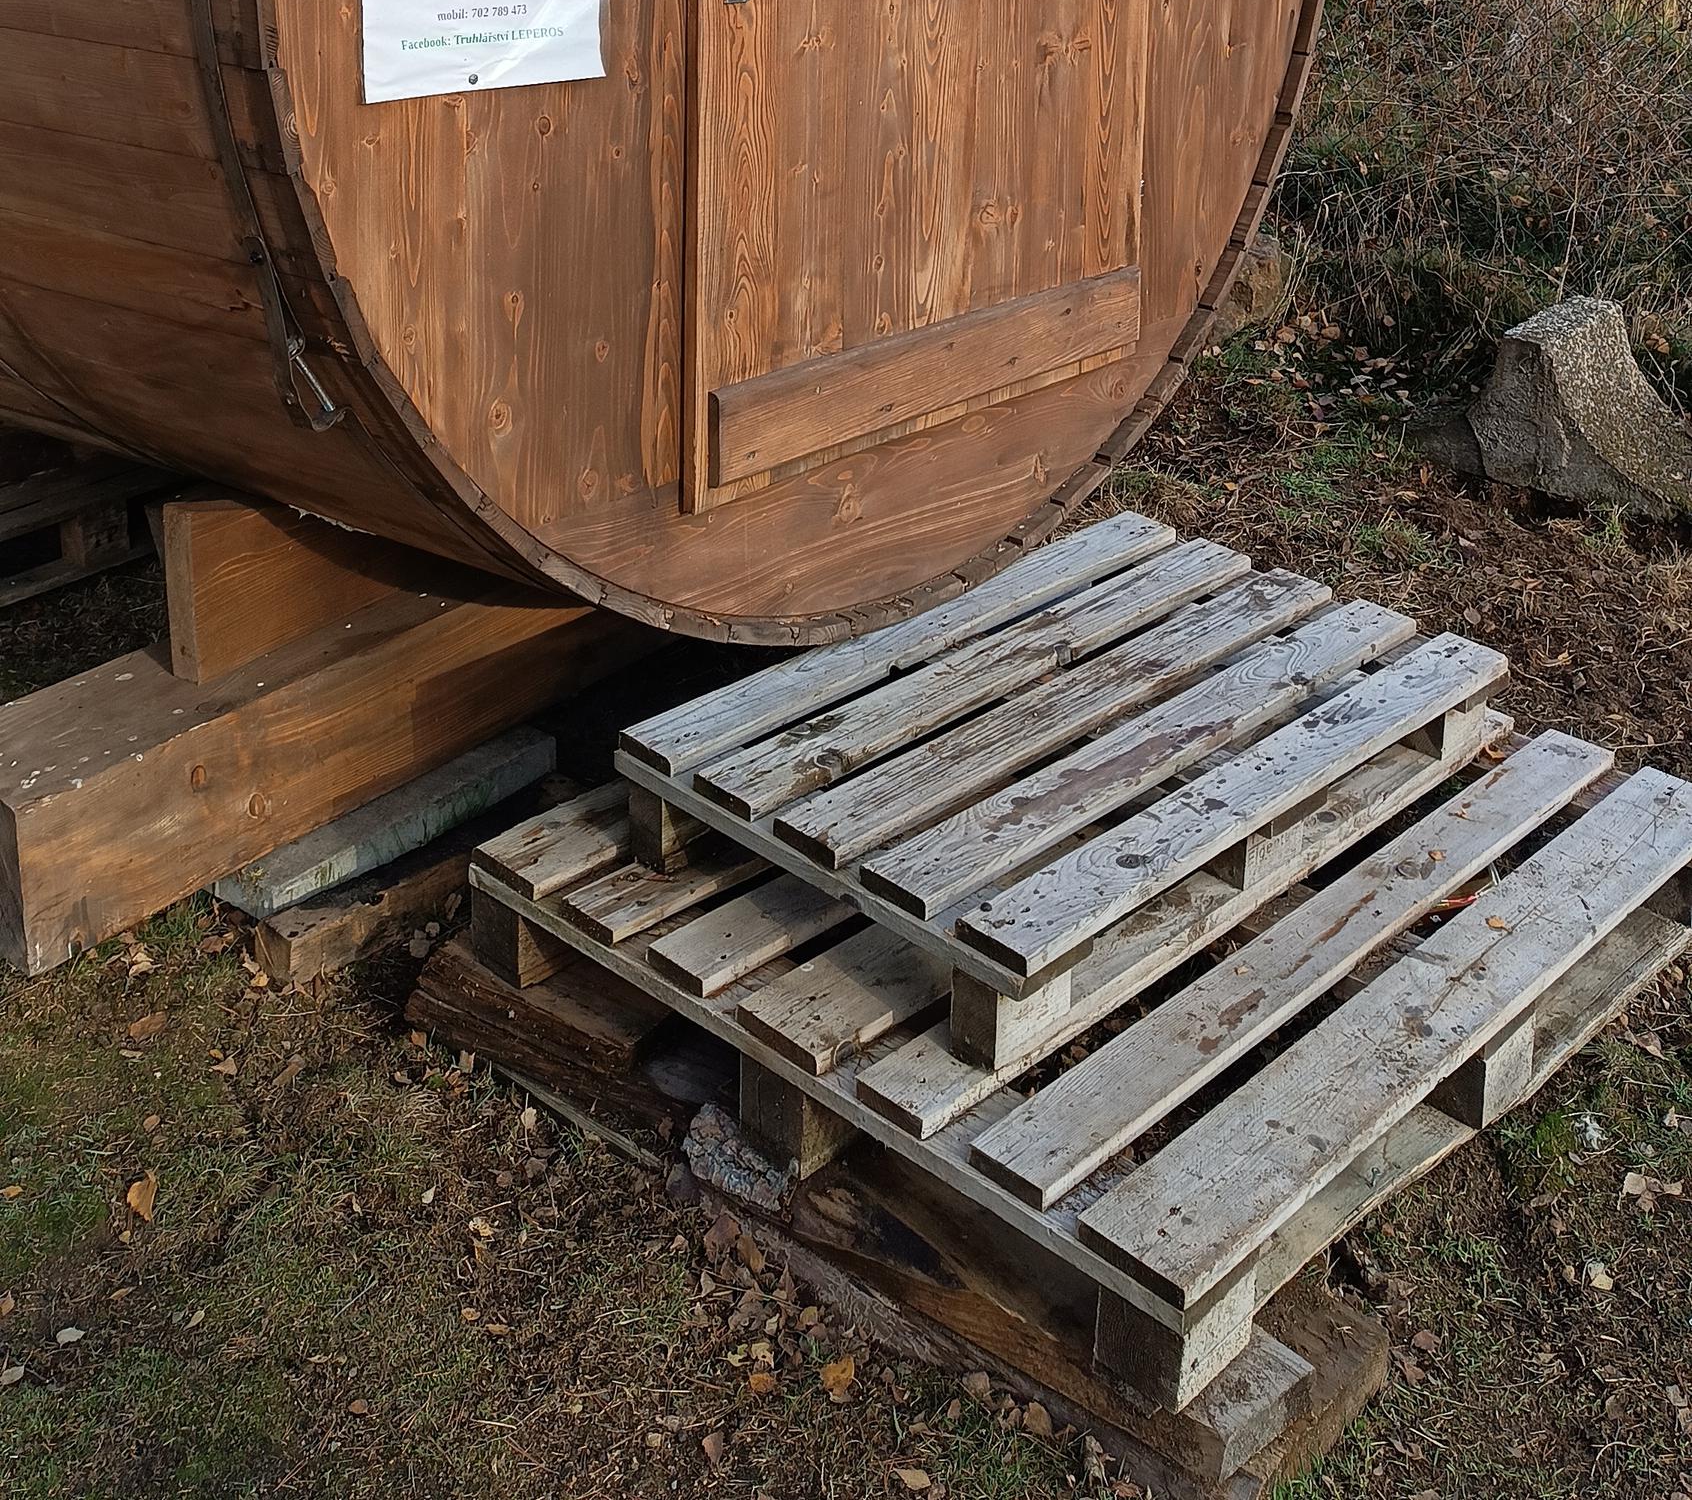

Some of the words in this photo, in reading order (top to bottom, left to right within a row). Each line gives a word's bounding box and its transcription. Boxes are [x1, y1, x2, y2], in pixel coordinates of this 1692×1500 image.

[437, 9, 468, 21] mobil:
[472, 7, 489, 18] 702
[492, 6, 509, 17] 789
[511, 4, 528, 16] 473
[401, 36, 451, 51] Facebook:
[454, 31, 509, 46] Truhlářství
[511, 26, 564, 41] LEPEROS
